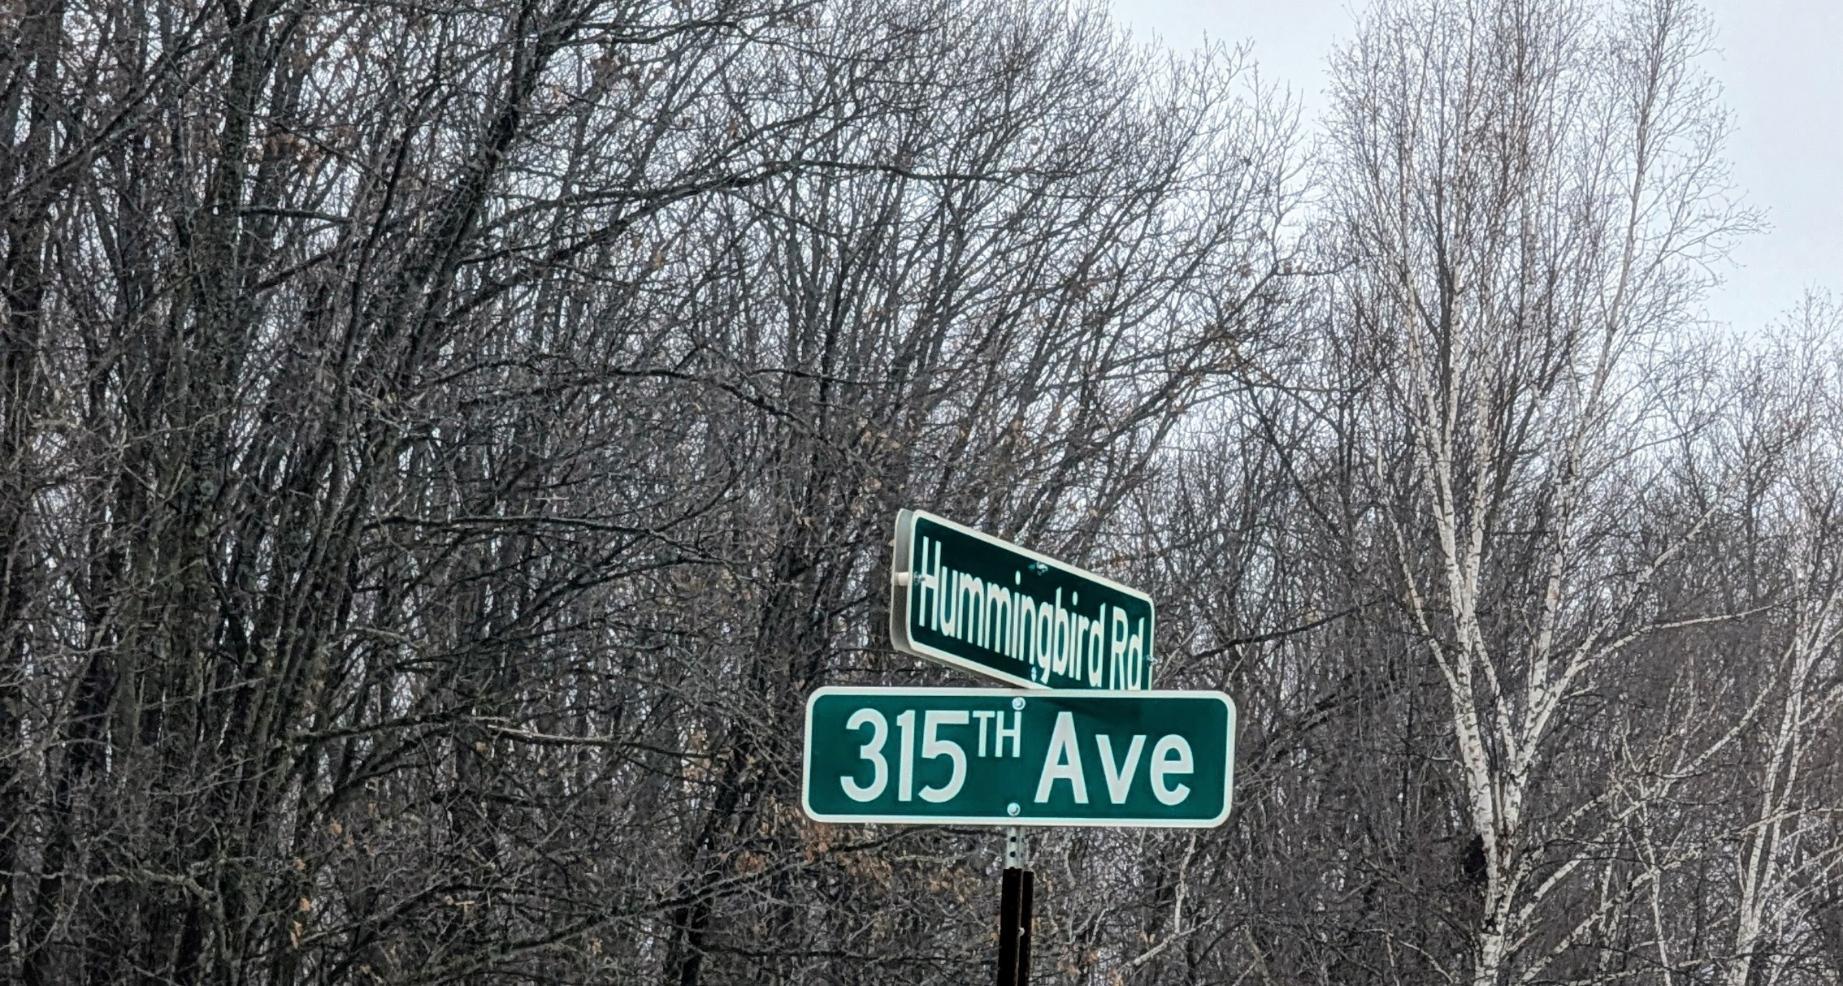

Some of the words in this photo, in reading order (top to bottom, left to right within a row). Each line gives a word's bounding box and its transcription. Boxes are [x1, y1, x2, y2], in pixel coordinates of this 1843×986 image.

[918, 536, 1106, 688] Hummingbird
[1110, 605, 1145, 690] Rd
[1034, 711, 1194, 805] Ave
